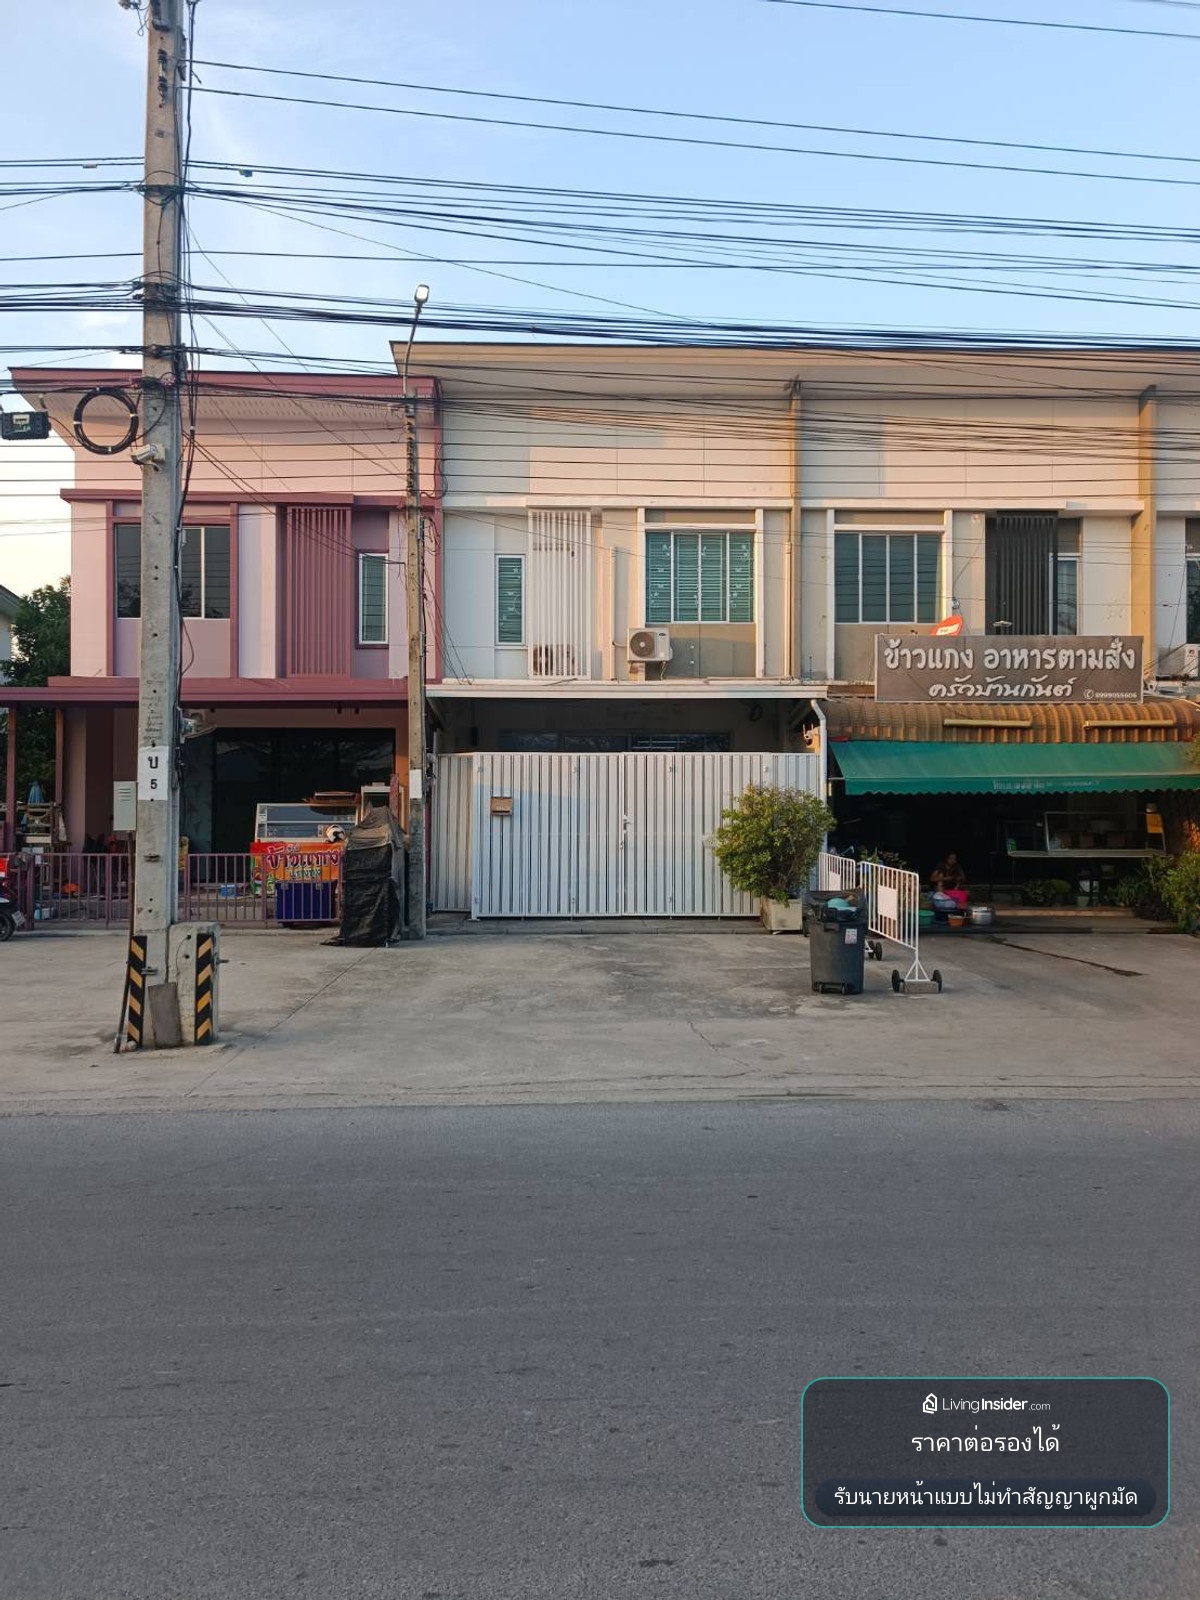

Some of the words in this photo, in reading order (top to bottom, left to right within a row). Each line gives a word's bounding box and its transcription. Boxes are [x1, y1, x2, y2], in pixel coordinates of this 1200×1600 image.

[883, 639, 975, 670] ข้าวแกง
[983, 637, 1136, 670] อาหารตามสั่ง
[928, 674, 1078, 698] ครัวบ้านกันต์
[150, 779, 158, 790] 5
